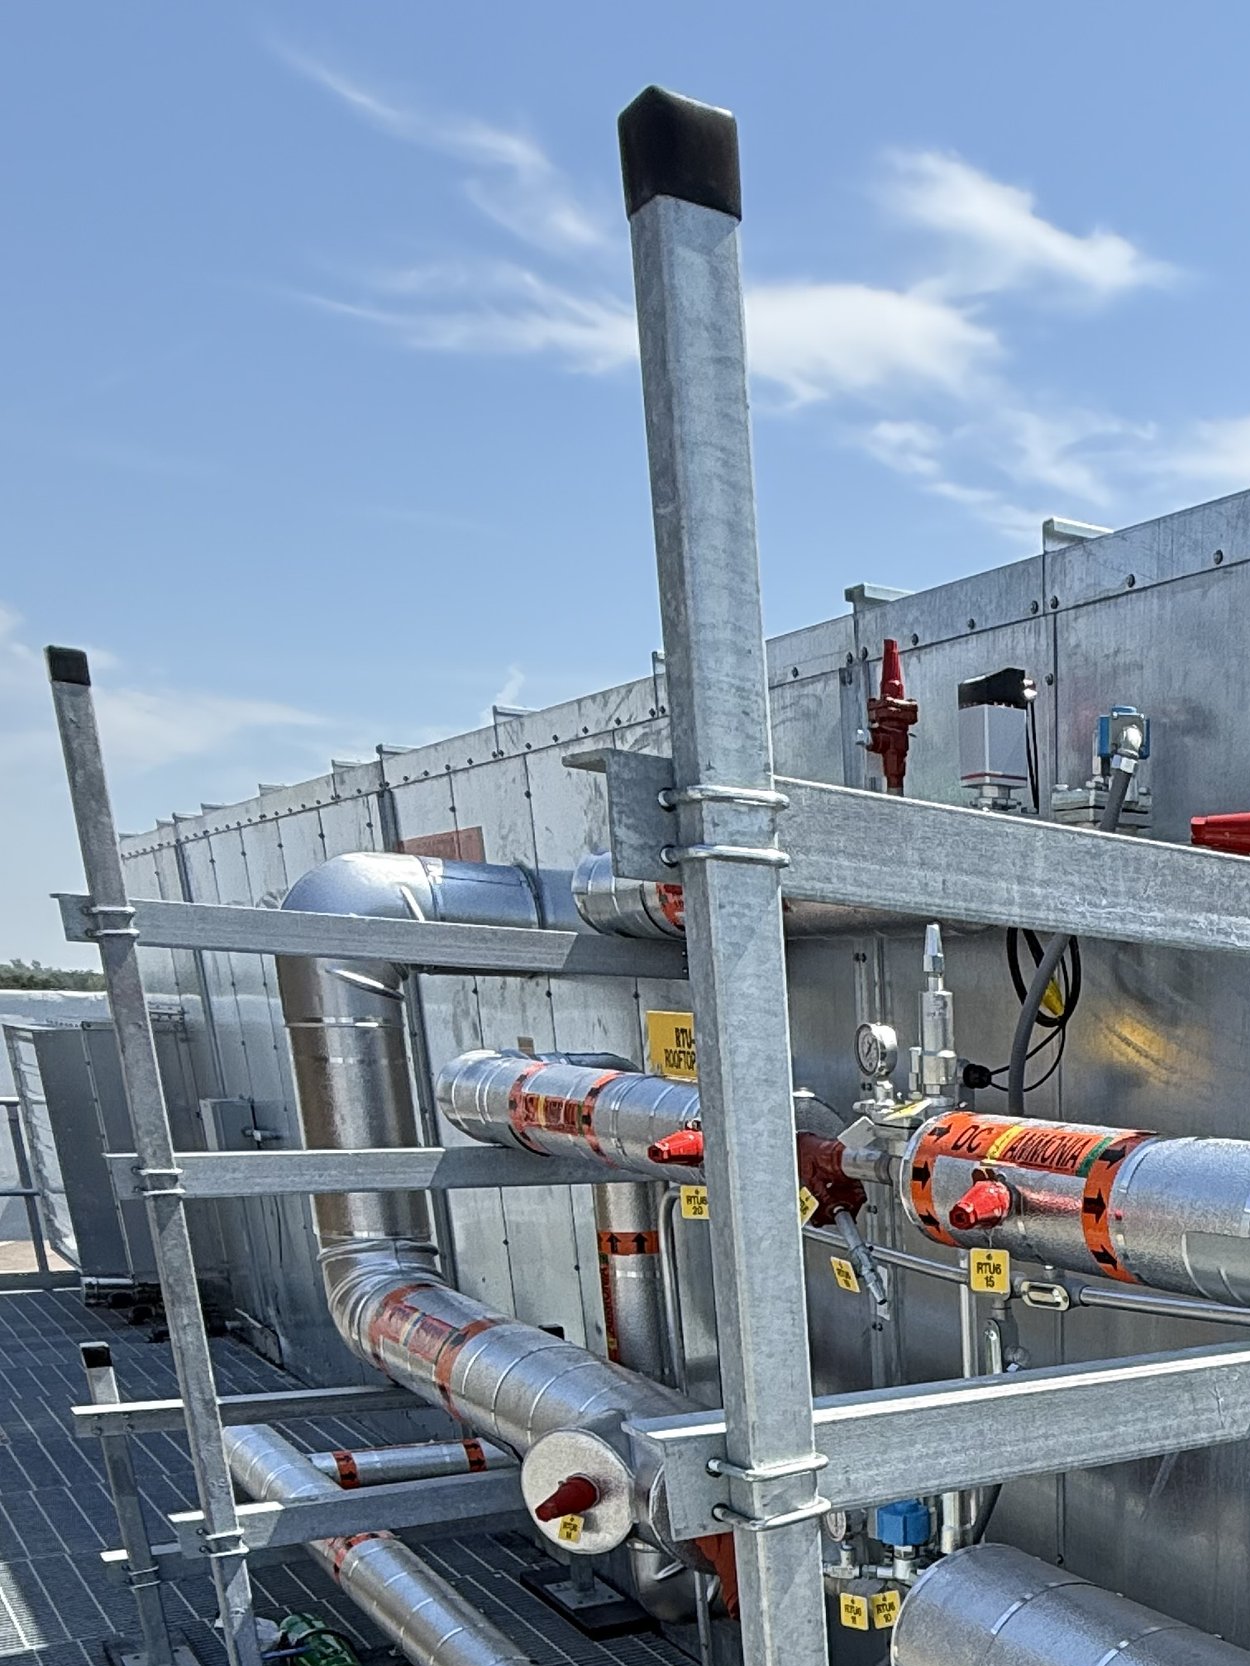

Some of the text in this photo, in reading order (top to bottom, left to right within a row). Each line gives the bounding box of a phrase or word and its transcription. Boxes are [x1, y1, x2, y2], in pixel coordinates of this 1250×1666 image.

[951, 1124, 993, 1153] DC
[1003, 1131, 1092, 1168] AMMONIA
[976, 1261, 1002, 1275] RTU6
[984, 1275, 995, 1288] 15
